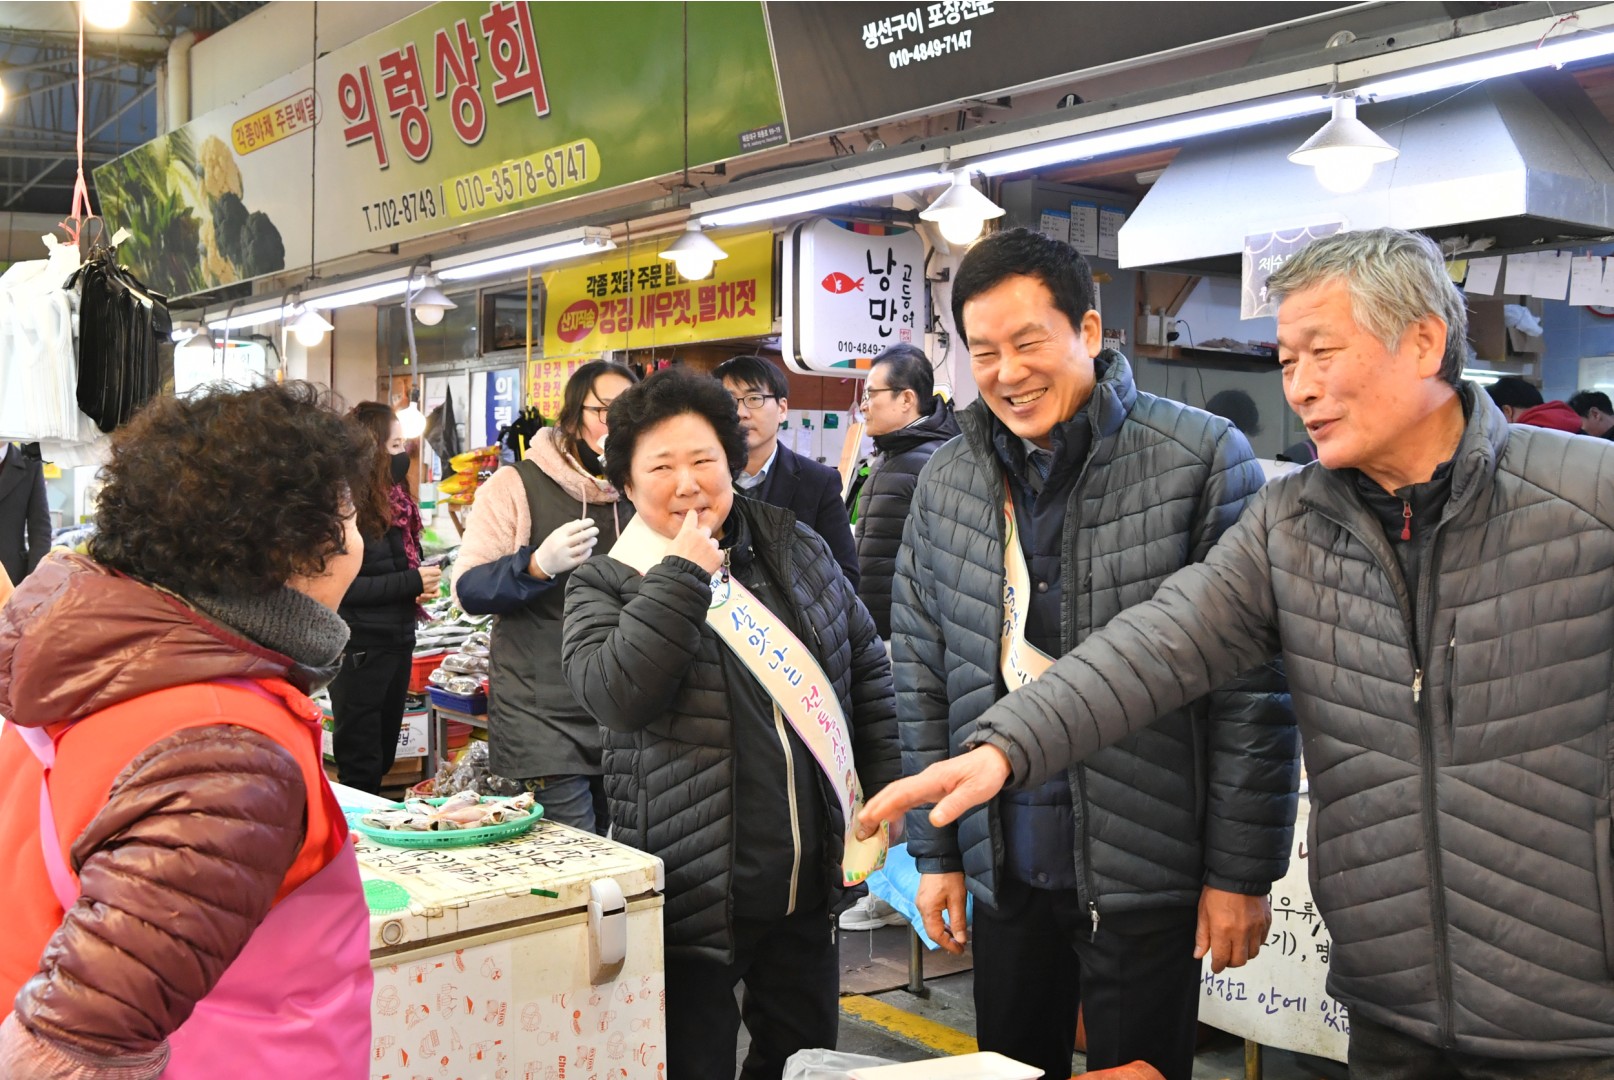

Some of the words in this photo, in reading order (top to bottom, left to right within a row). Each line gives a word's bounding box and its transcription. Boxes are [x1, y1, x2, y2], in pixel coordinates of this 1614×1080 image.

[862, 8, 924, 49] 생선구이
[889, 29, 972, 69] 010-4849-7147
[338, 1, 549, 168] 의령상회
[362, 188, 437, 232] T.702-8743
[456, 143, 588, 212] 010-3578-8747
[586, 274, 608, 298] 각종
[611, 269, 635, 294] 젓갈
[637, 264, 662, 290] 주문
[866, 247, 898, 338] 낭만
[901, 264, 914, 328] 고등어
[560, 309, 597, 334] 산지직송
[838, 340, 887, 355] 010-4849-7
[730, 604, 803, 686] 살맛나는
[800, 685, 847, 772] 전통시장
[1258, 986, 1307, 1015] 안에
